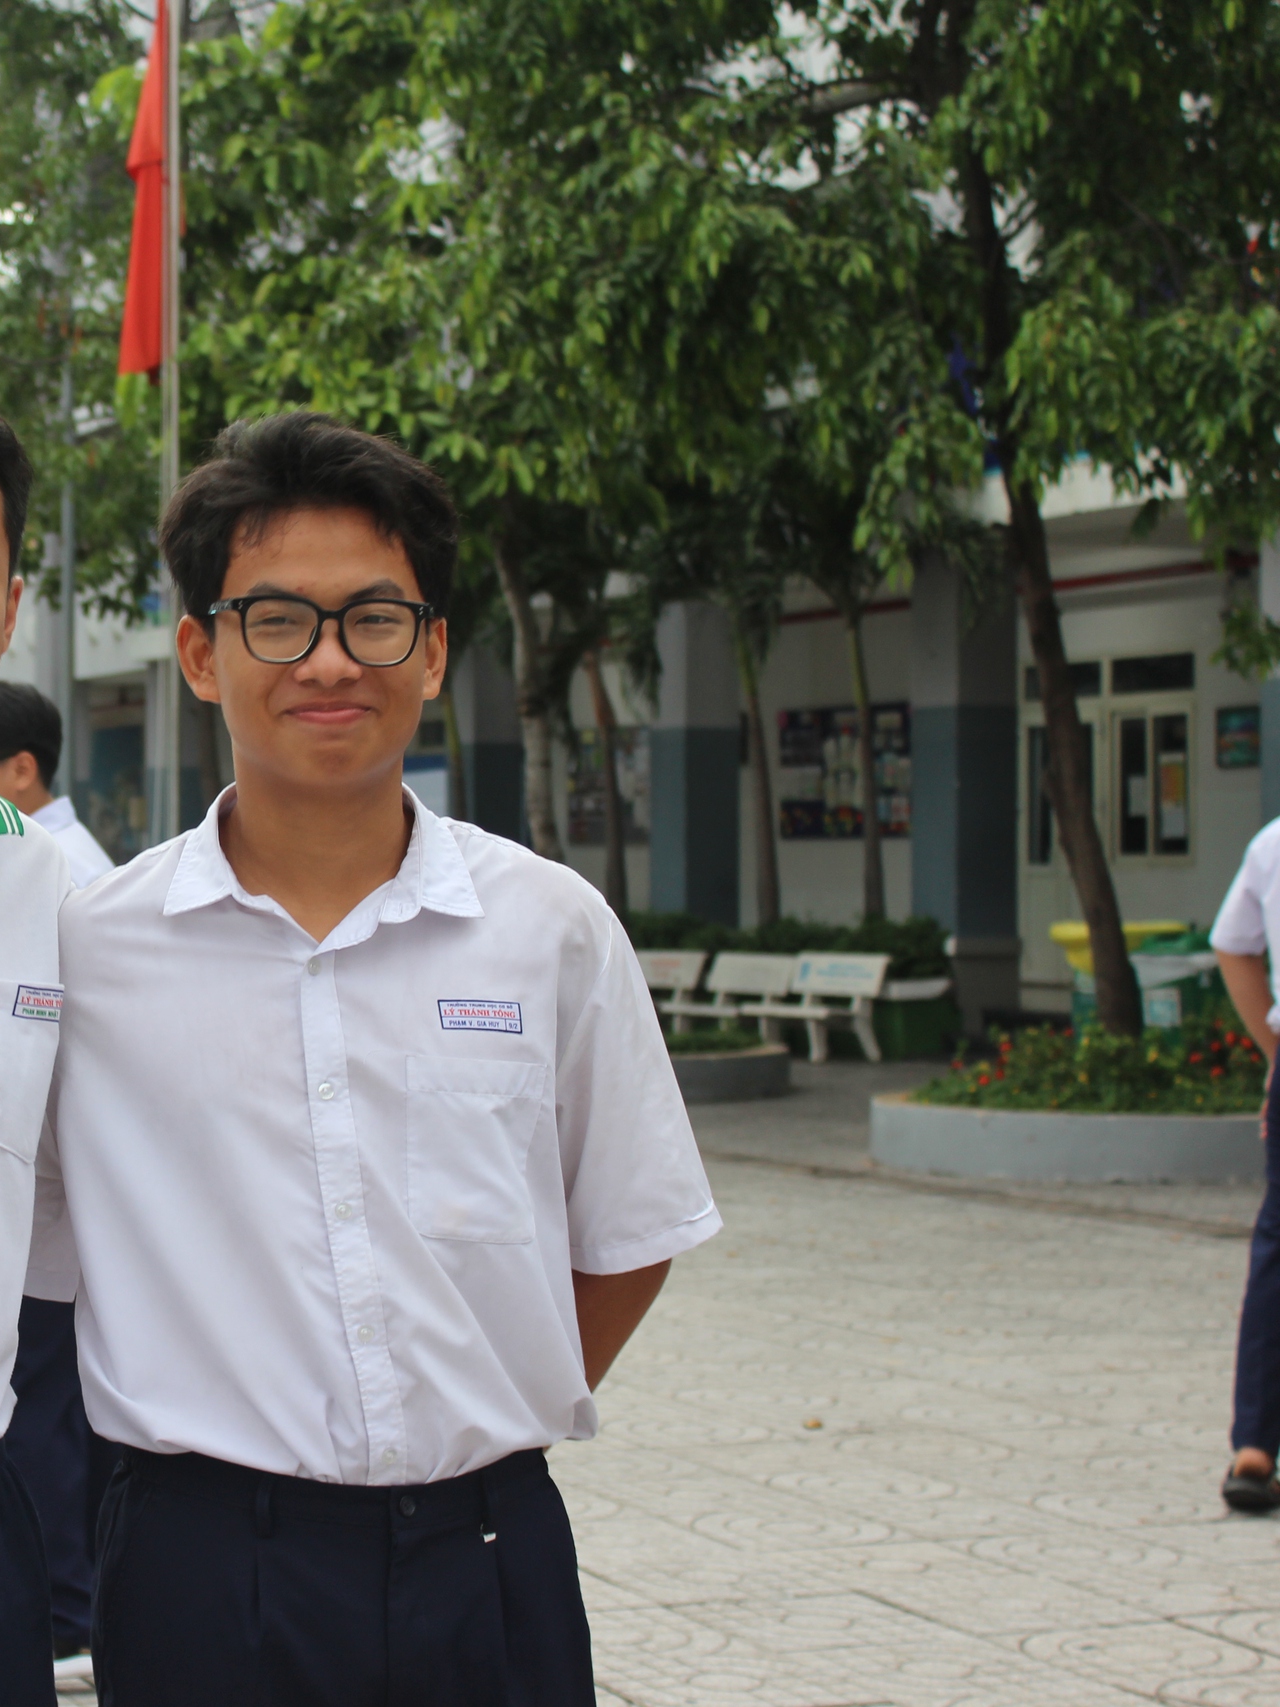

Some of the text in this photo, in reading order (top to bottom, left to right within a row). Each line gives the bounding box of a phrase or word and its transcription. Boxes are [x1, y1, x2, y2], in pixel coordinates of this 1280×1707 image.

[21, 995, 31, 1004] LÝ
[443, 1007, 516, 1019] LÝ THÁNH TÔNG
